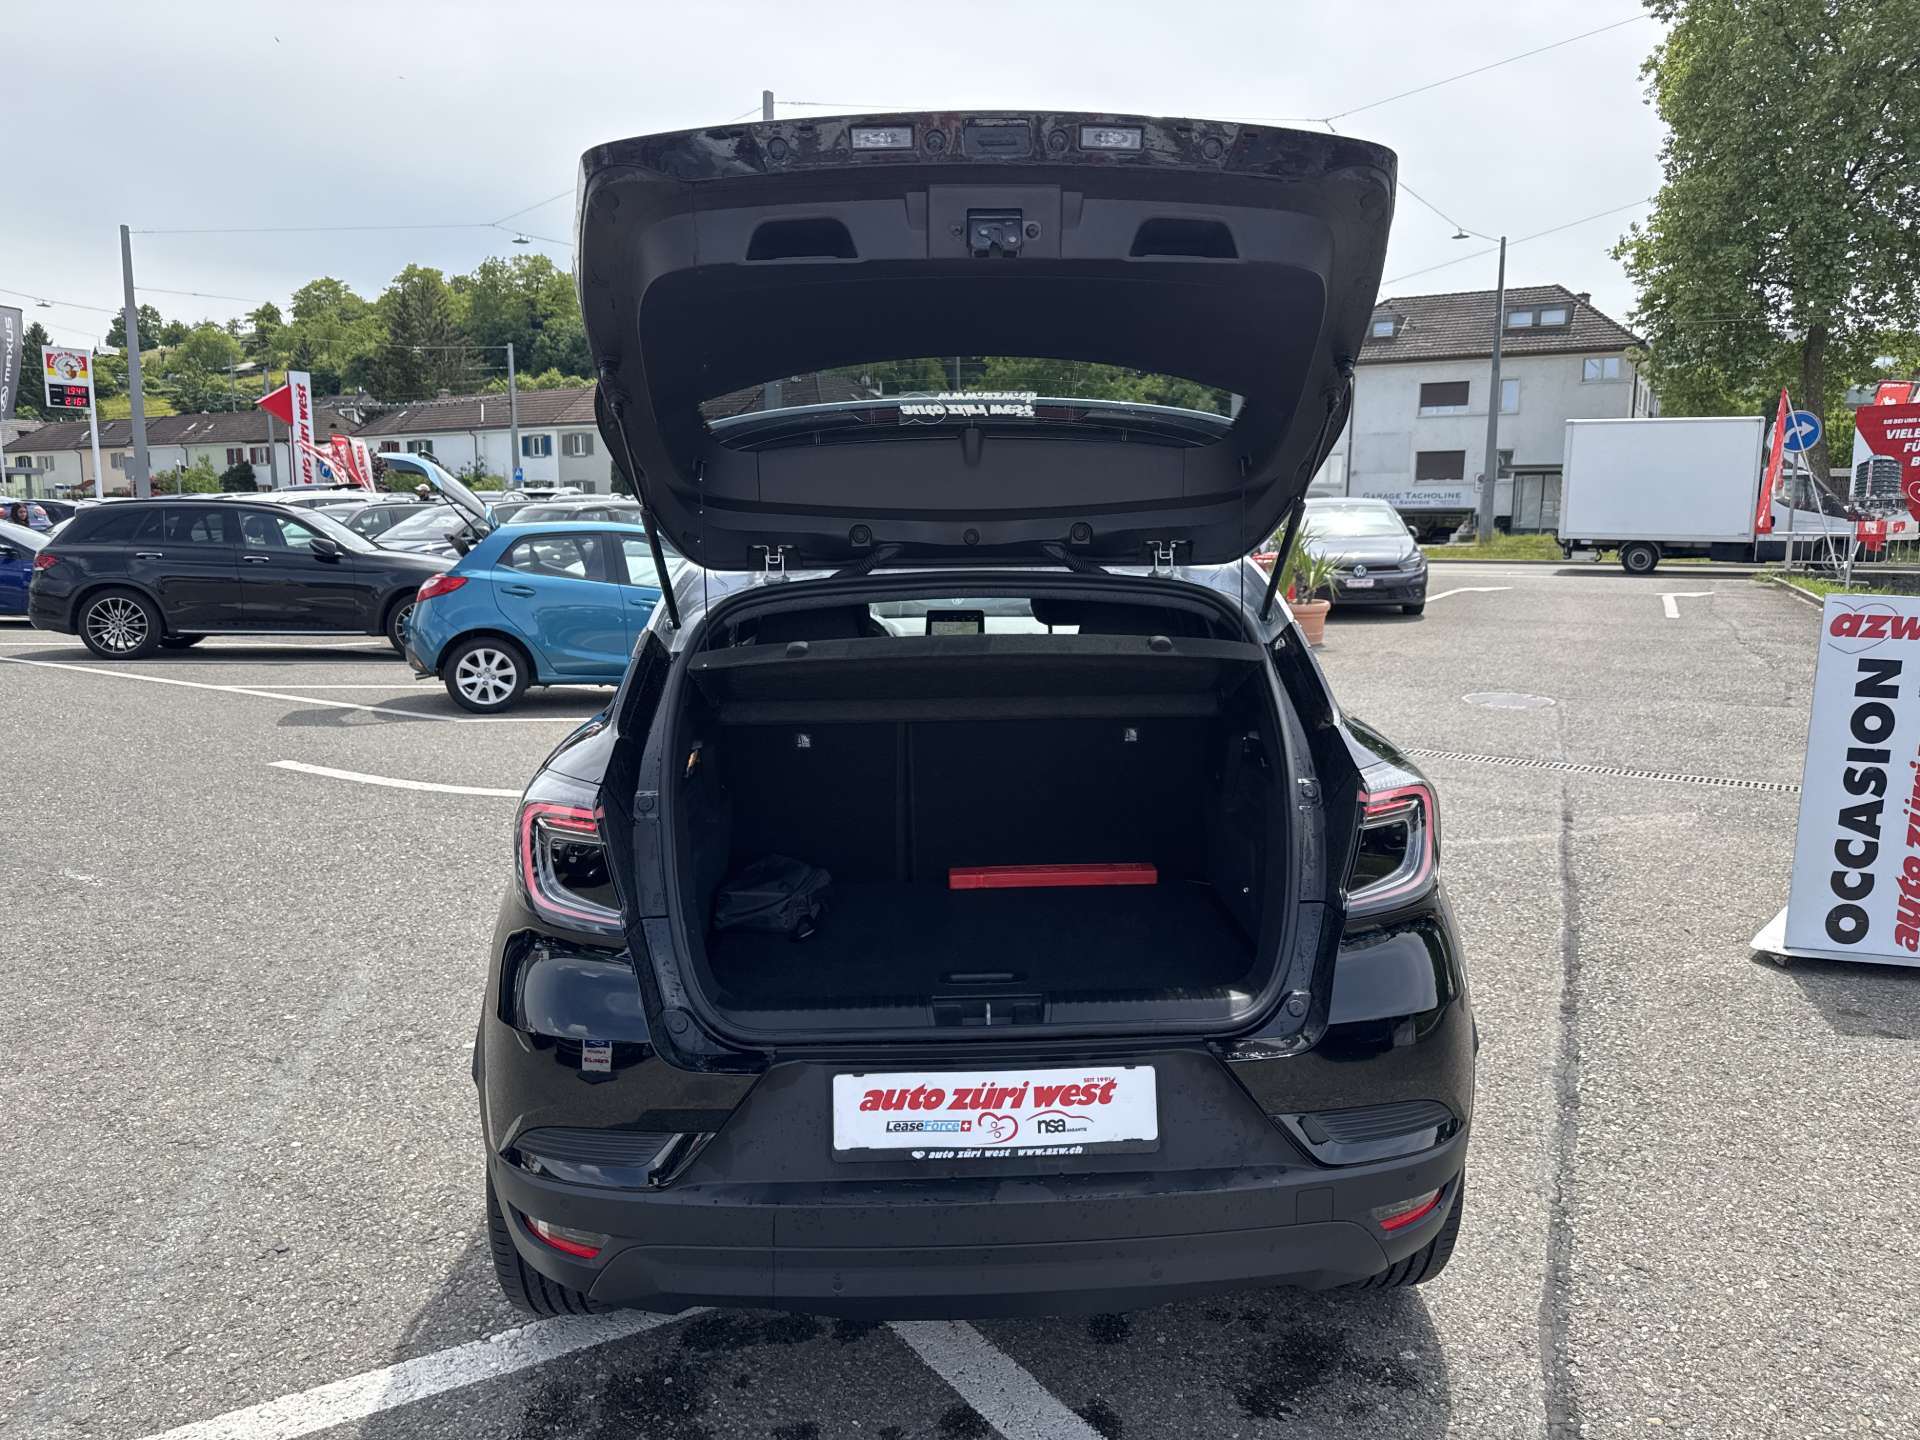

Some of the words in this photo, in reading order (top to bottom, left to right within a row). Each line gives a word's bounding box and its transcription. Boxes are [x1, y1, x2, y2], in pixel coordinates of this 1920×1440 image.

[1825, 657, 1903, 945] OCCASION
[859, 1083, 946, 1111] auto
[946, 1080, 1030, 1110] züri
[1033, 1077, 1117, 1108] west
[886, 1119, 960, 1133] LeaseForce
[1037, 1118, 1066, 1134] nsa
[928, 1151, 954, 1159] auto
[985, 1149, 1010, 1158] west
[1017, 1145, 1083, 1157] www.azw.ch
